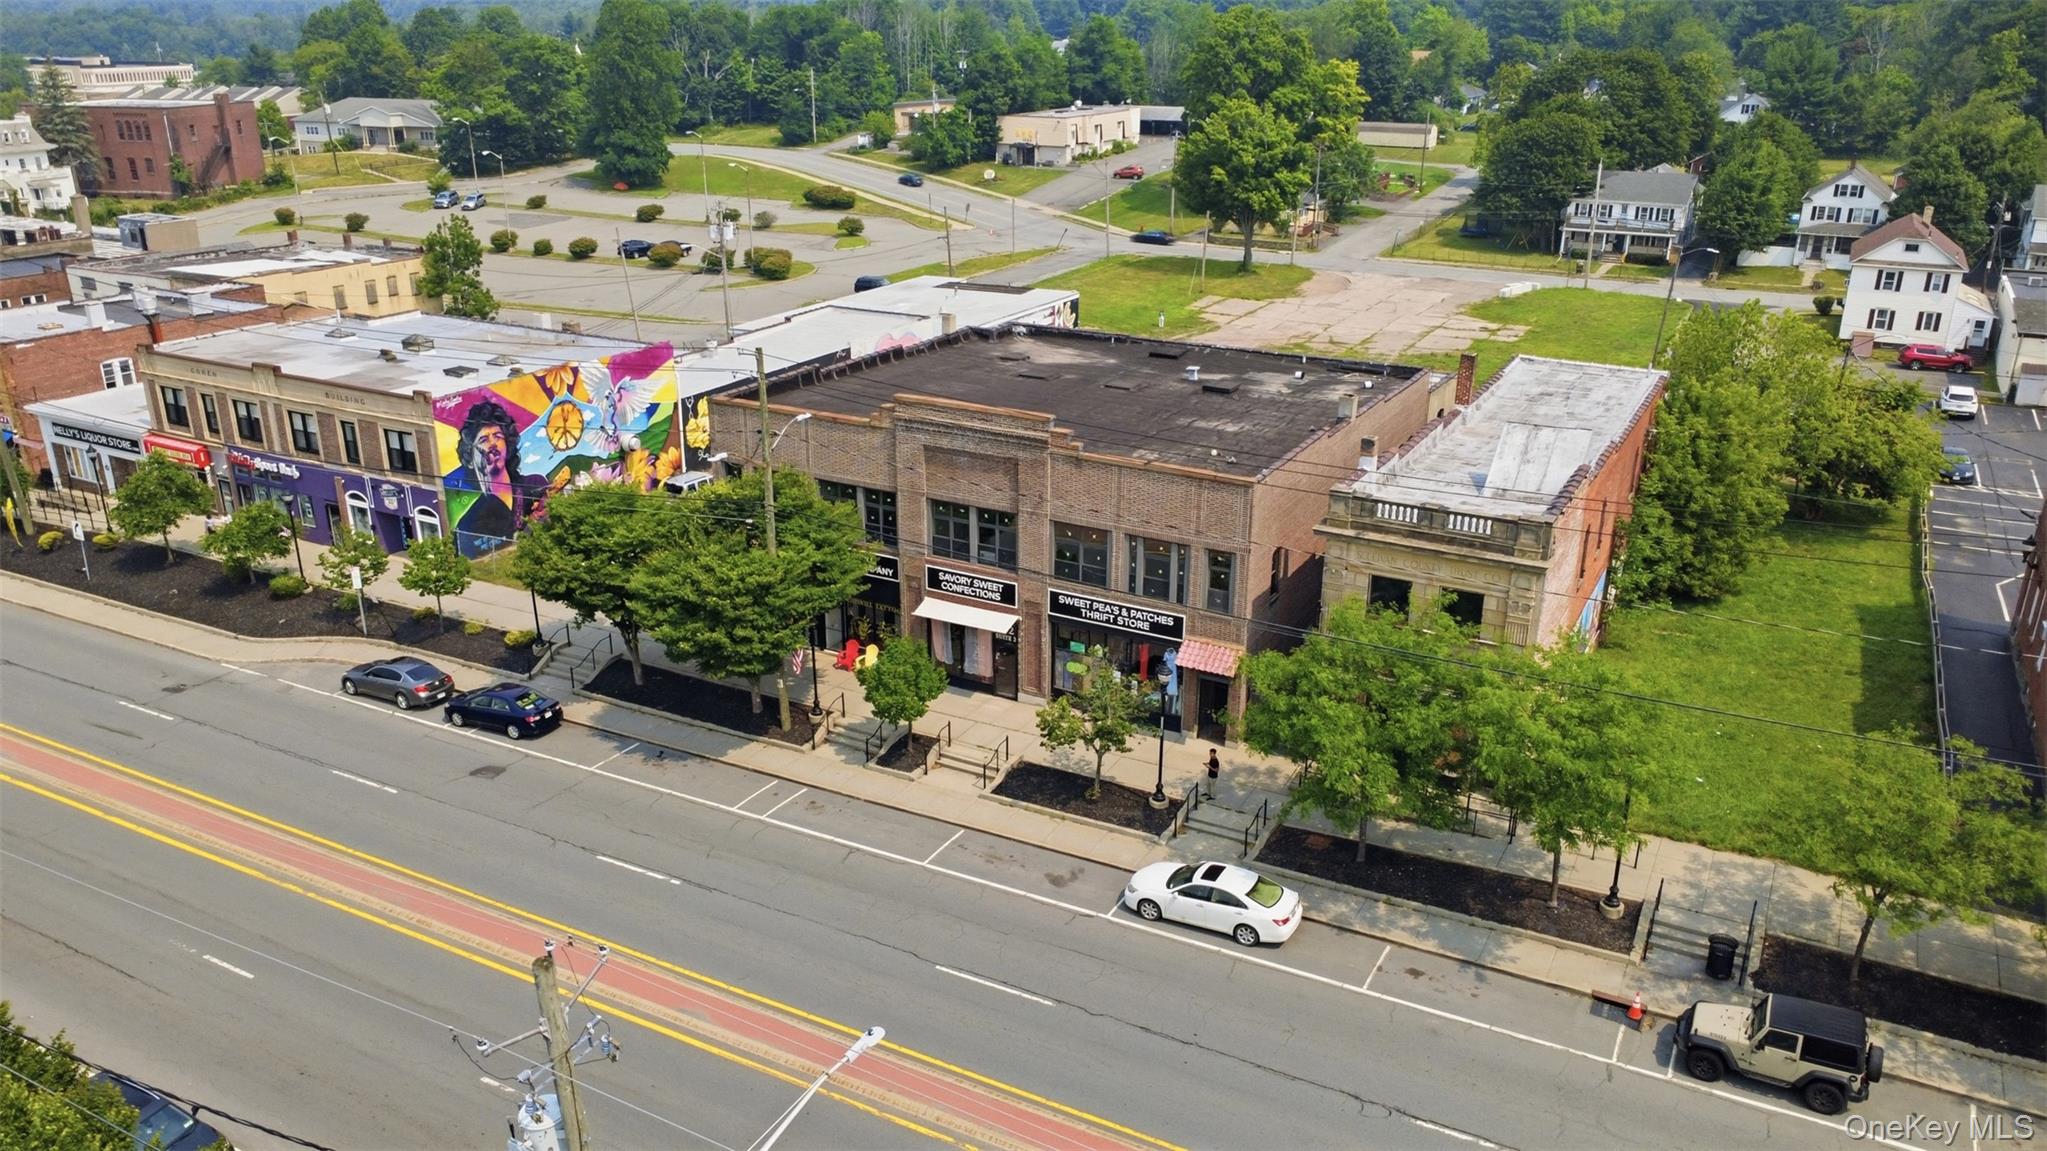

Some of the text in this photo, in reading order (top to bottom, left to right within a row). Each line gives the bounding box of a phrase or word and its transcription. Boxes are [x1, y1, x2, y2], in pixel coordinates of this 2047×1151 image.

[53, 425, 131, 449] NELLY'S LIQUOR STORE
[938, 572, 1004, 593] SAVORY SWEET
[941, 581, 1001, 601] CONFECTIONS
[1058, 595, 1175, 626] SWEET PEA'S & PATCHES
[1080, 608, 1150, 630] THRIFT STORE
